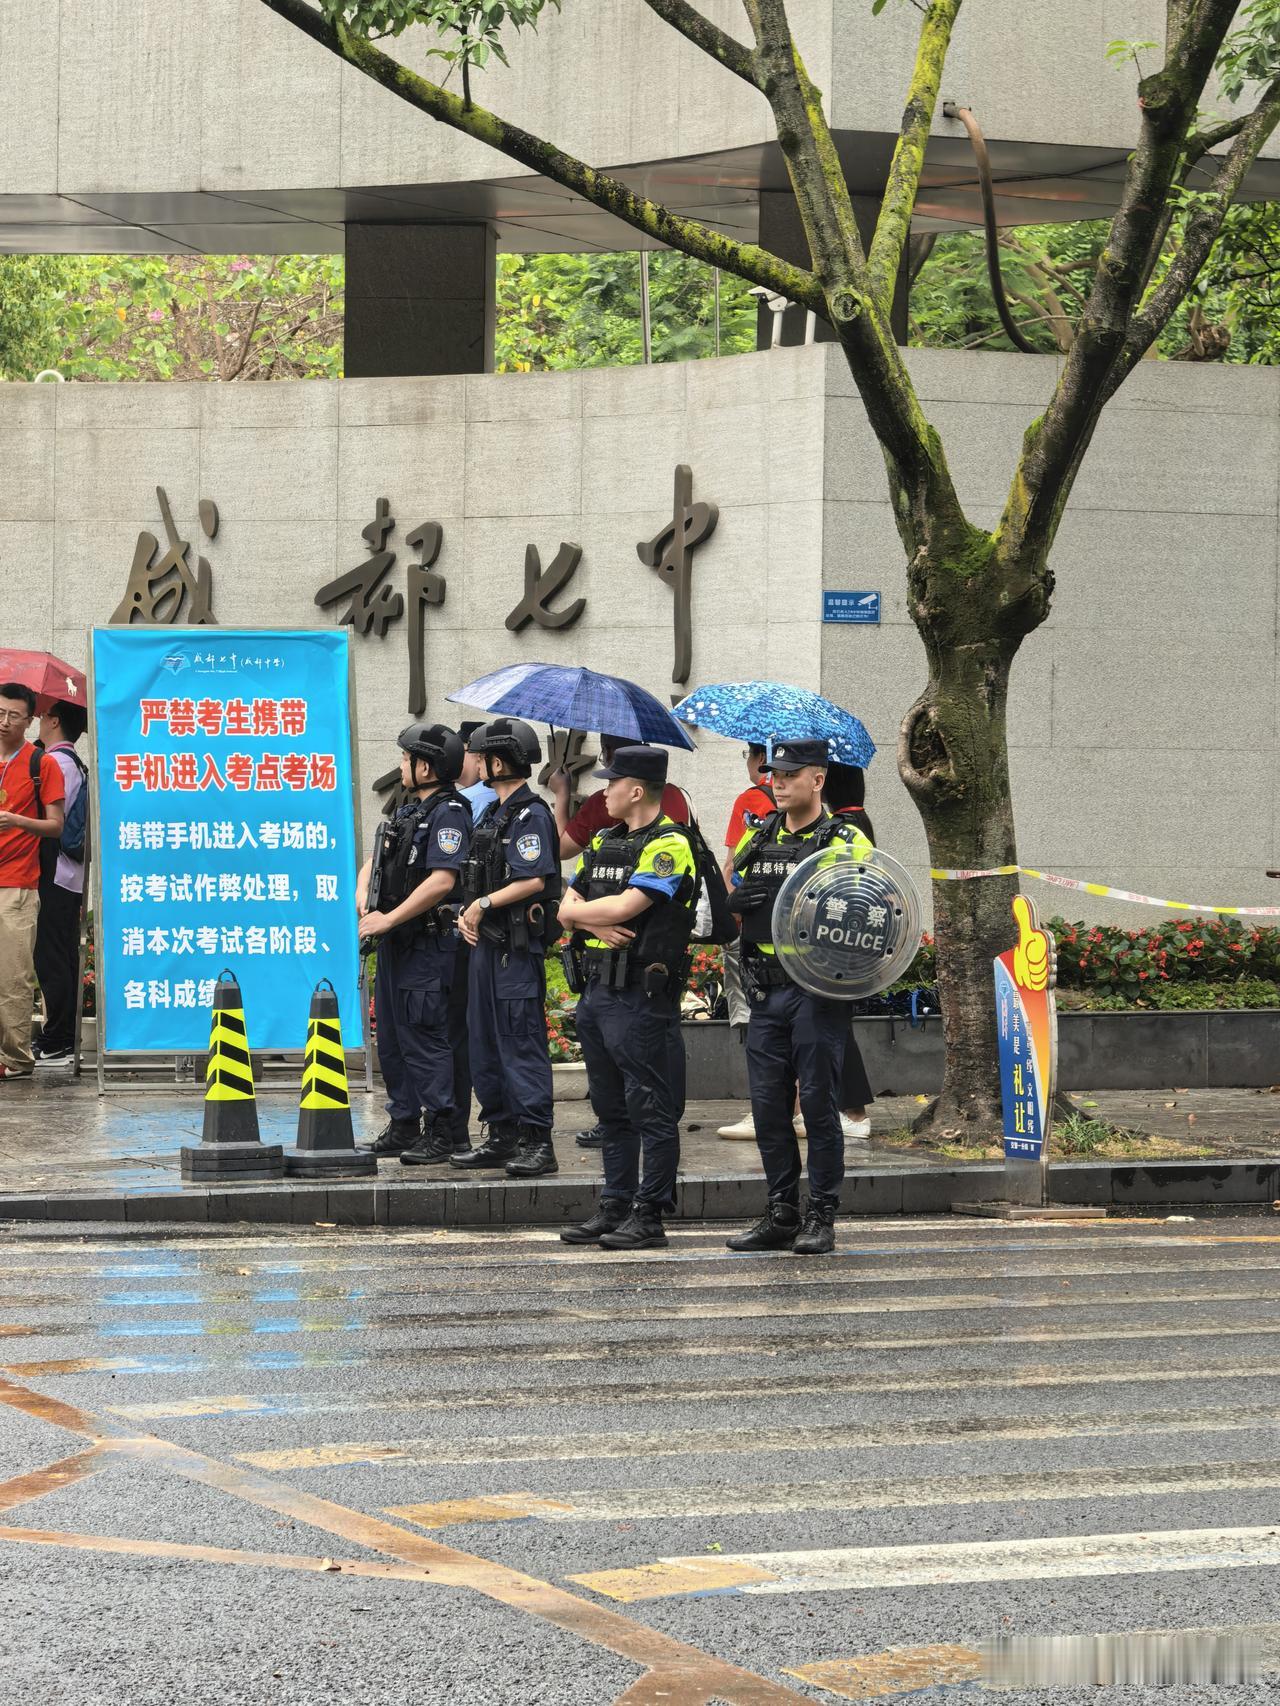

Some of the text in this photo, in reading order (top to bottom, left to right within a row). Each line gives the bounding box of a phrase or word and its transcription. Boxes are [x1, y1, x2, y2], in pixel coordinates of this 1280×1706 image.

[140, 698, 307, 737] 严禁考生携带
[114, 752, 337, 792] 手机进入考点考场
[118, 821, 338, 851] 携带手机进入考场的，
[751, 861, 798, 875] 成都特警
[824, 896, 888, 928] 警察
[122, 926, 331, 956] 消本次考试各阶段、
[816, 924, 884, 951] POLICE
[123, 978, 218, 1010] 各科成绩
